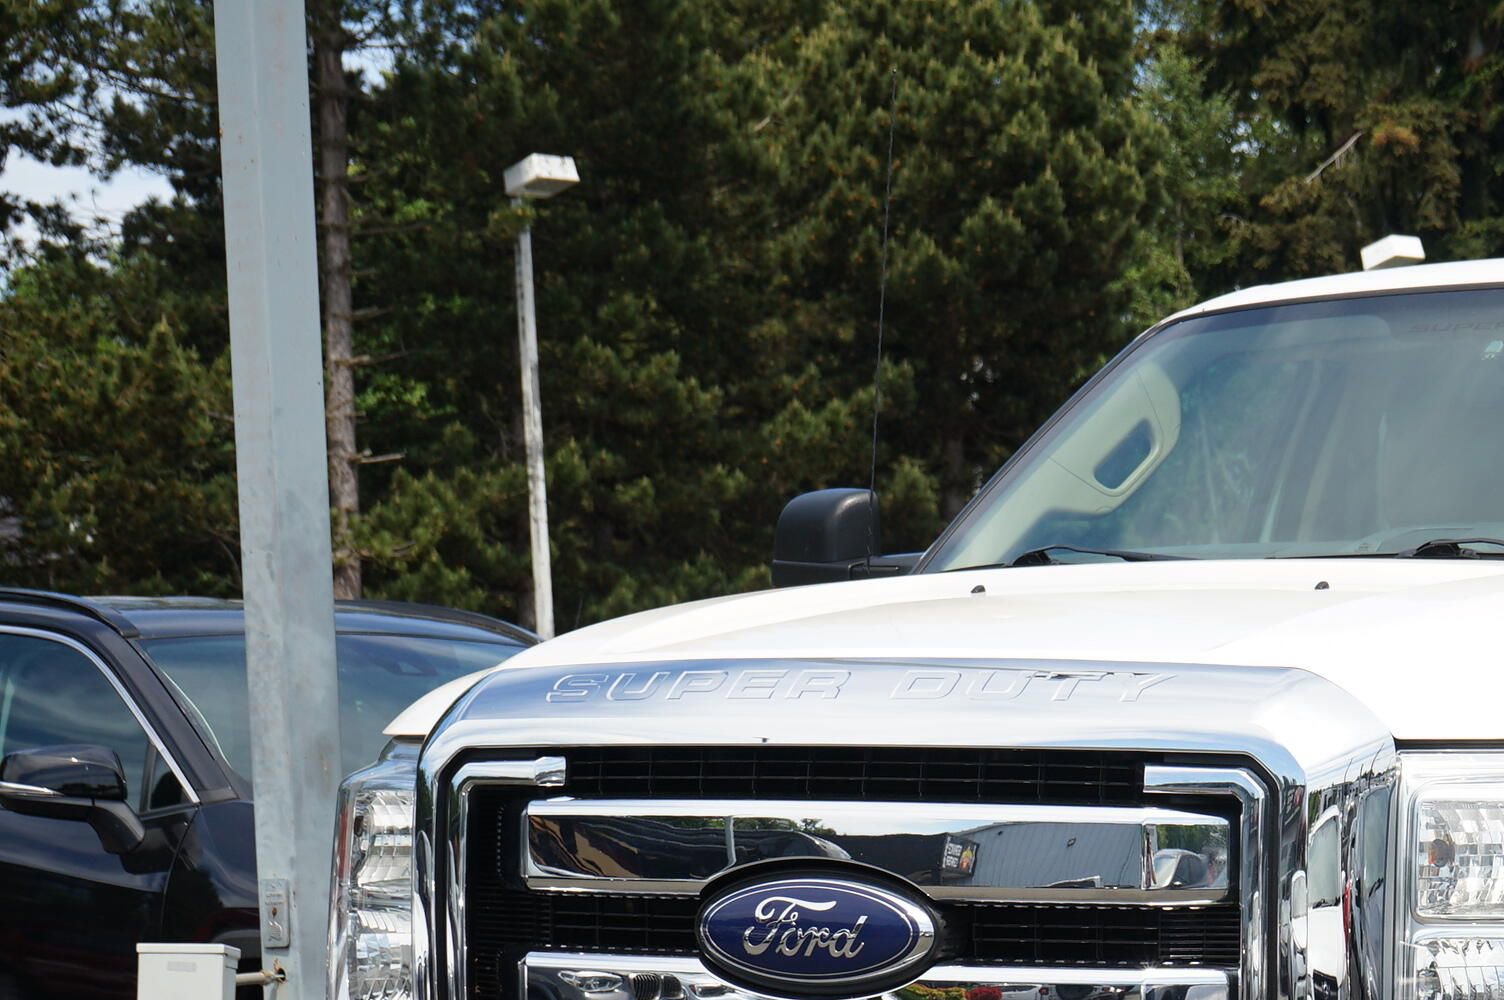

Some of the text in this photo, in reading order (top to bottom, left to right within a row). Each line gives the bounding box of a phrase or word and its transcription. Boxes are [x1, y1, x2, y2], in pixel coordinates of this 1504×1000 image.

[546, 669, 1177, 702] SUPER DUTY
[743, 896, 869, 958] Ford
